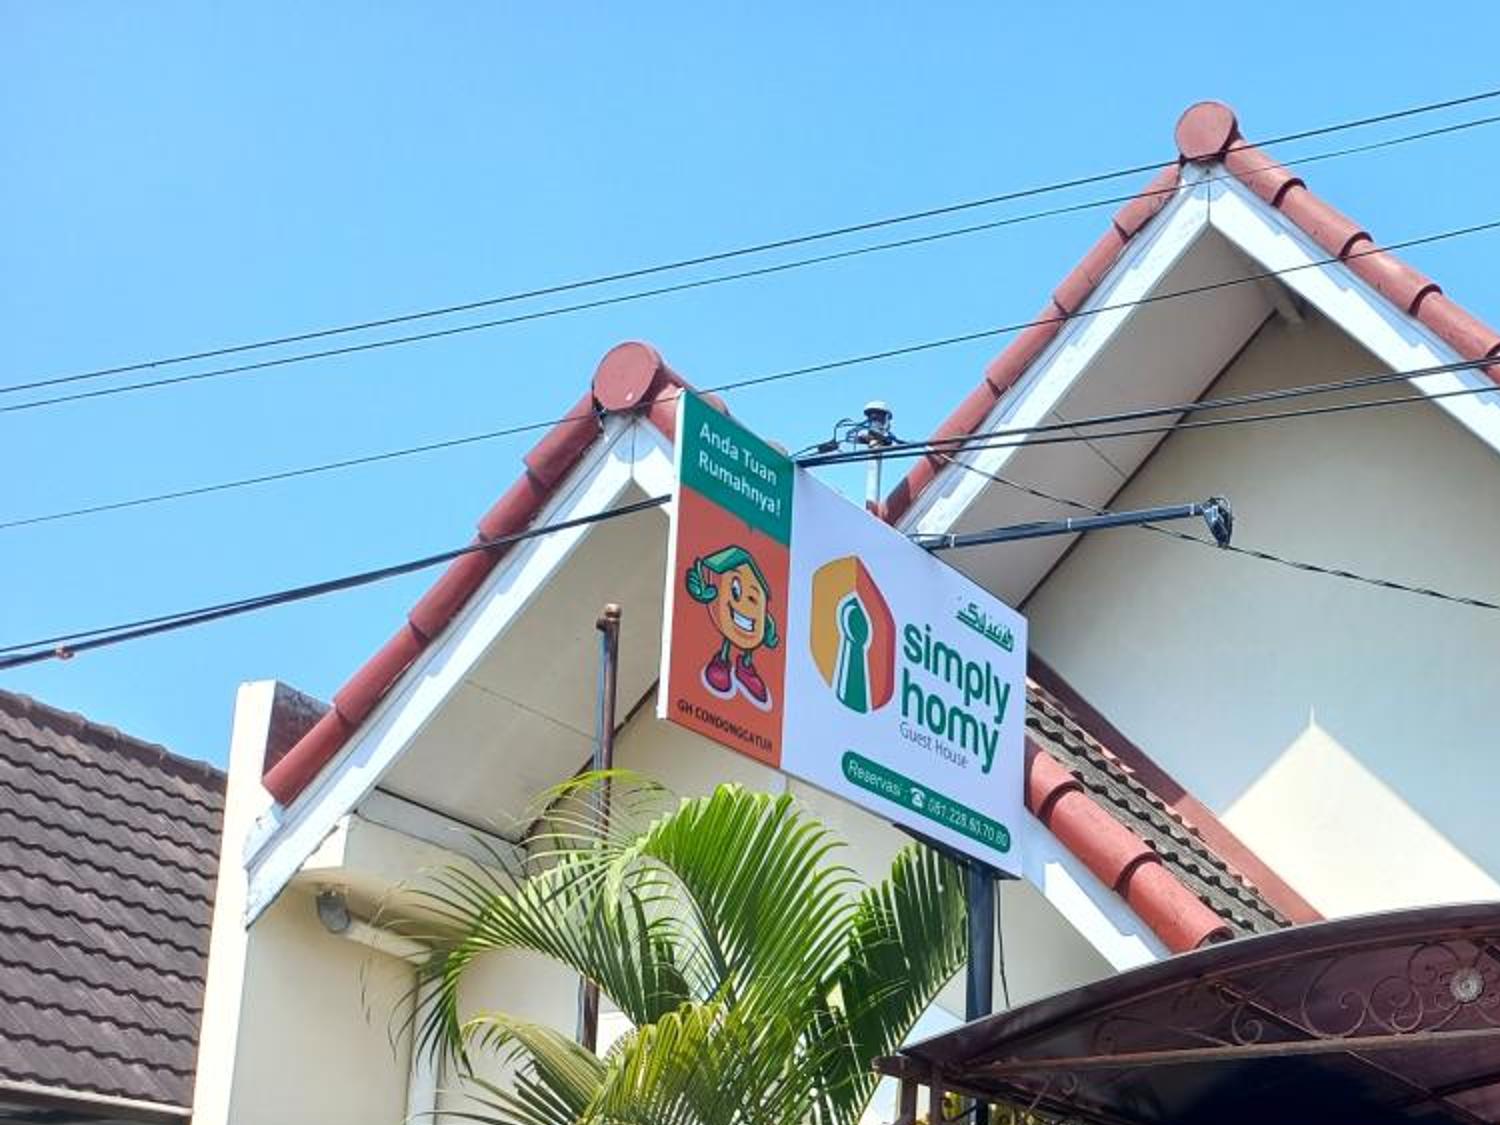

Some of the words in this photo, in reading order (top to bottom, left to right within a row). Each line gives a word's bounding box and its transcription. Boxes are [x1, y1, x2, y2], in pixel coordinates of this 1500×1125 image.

[699, 450, 781, 517] Rumahnya!
[700, 422, 739, 460] Anda
[742, 448, 777, 486] Tuan
[904, 624, 1010, 724] simply
[677, 698, 693, 716] GH
[902, 667, 998, 774] homy
[900, 721, 931, 751] Guest
[935, 738, 968, 768] House
[848, 759, 900, 796] Reservasi
